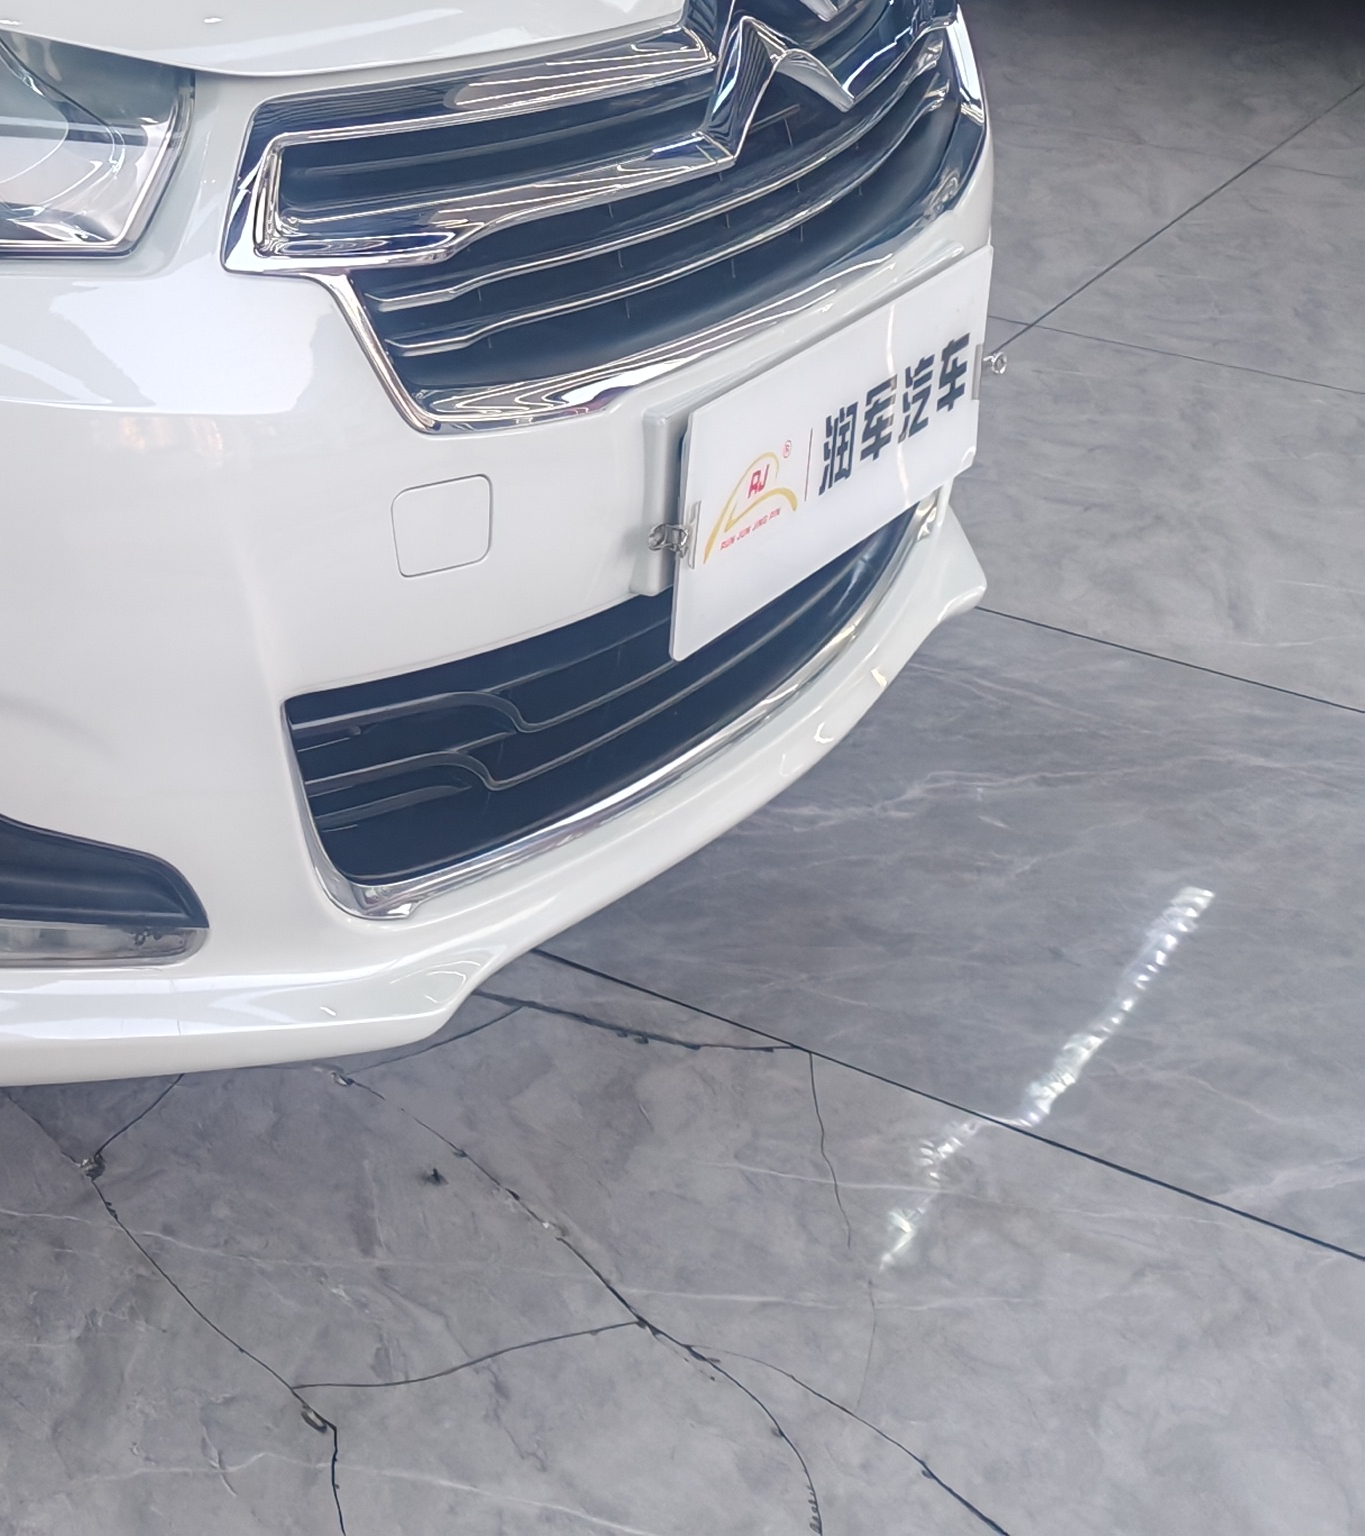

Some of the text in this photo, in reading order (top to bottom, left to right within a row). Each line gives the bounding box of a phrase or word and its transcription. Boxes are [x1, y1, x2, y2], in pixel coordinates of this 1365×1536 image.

[818, 332, 971, 496] 润军汽车
[747, 463, 770, 499] RJ
